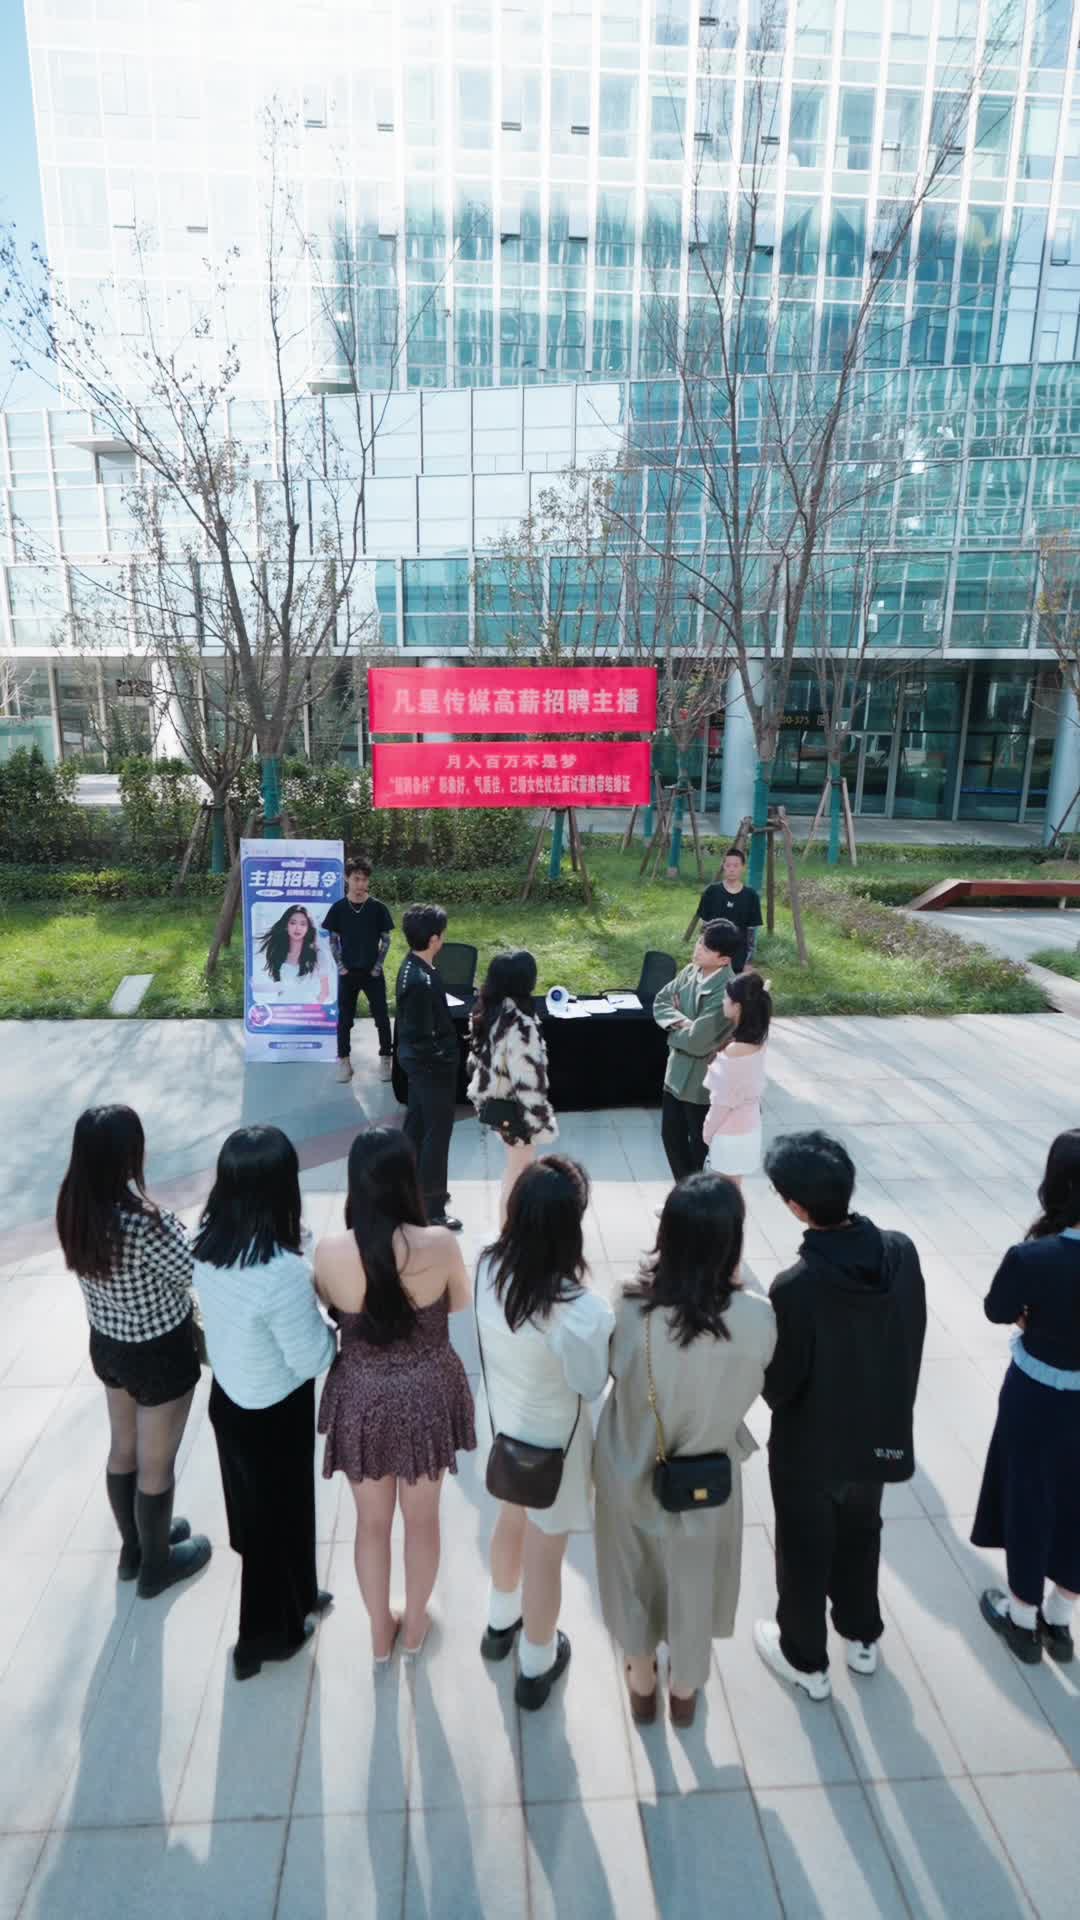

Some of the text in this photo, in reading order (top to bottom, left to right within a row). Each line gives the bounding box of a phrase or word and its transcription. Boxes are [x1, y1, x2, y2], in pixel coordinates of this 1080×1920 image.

[446, 754, 577, 769] 月入百万不是梦
[248, 870, 338, 888] 主播招募令
